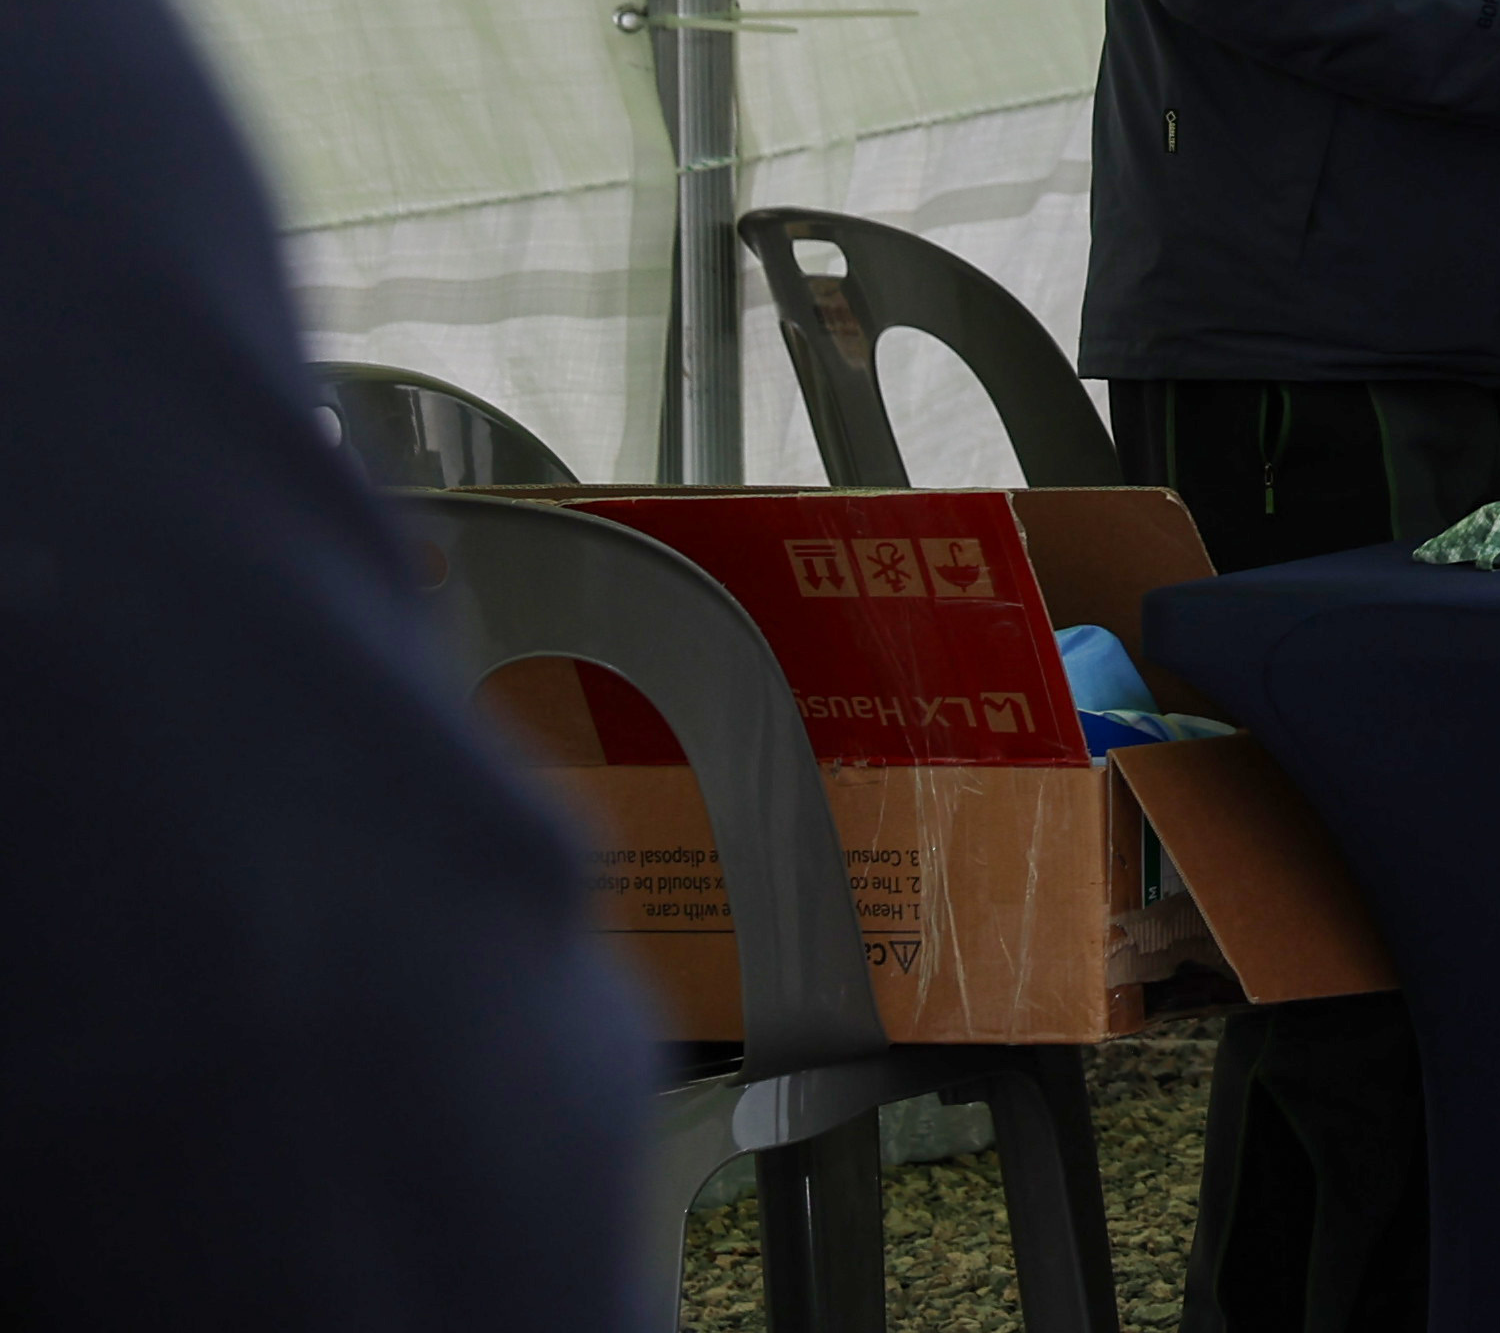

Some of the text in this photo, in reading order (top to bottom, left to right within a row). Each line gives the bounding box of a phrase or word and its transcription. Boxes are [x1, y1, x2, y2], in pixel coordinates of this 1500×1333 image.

[913, 695, 977, 727] LX
[640, 846, 706, 868] disposal
[906, 849, 920, 867] 3.
[634, 876, 653, 894] be
[658, 876, 711, 894] should
[872, 876, 903, 894] The
[906, 876, 920, 894] 2.
[643, 903, 680, 919] care.
[684, 903, 718, 921] with
[906, 903, 920, 920] 1.
